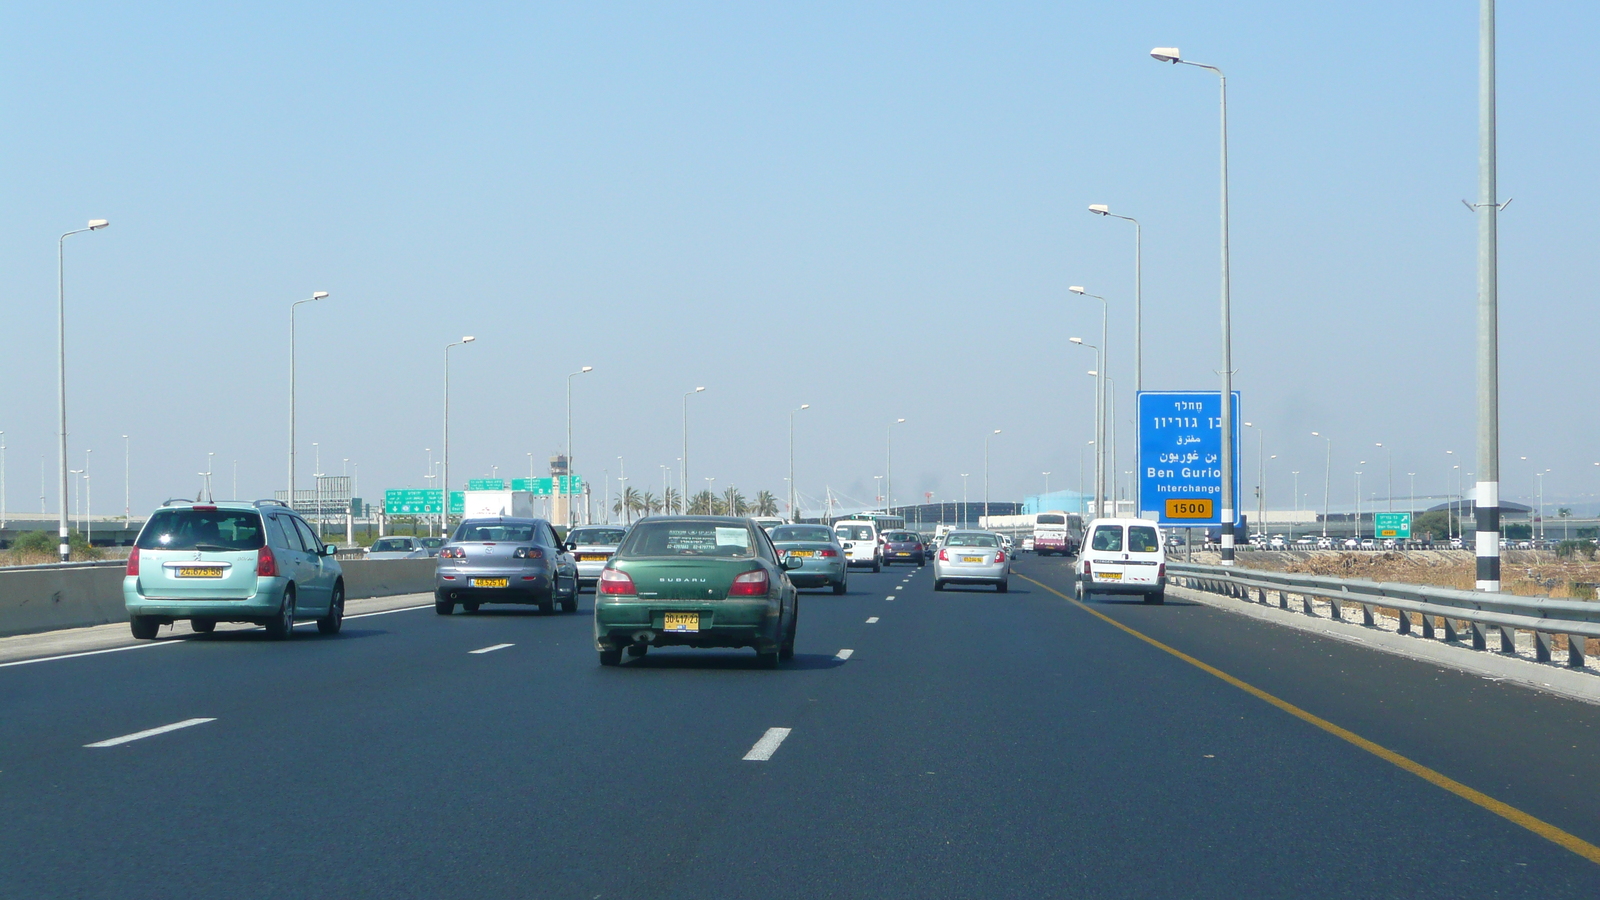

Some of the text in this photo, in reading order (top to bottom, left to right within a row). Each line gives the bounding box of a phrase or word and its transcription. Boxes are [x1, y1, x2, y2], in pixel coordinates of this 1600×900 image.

[1154, 417, 1222, 430] בן גוריון
[1176, 434, 1201, 446] مفترق
[1159, 450, 1217, 464] بن غوريون
[1147, 467, 1221, 478] Ben Gurio
[1157, 484, 1220, 494] Interchange
[1173, 503, 1205, 514] 1500
